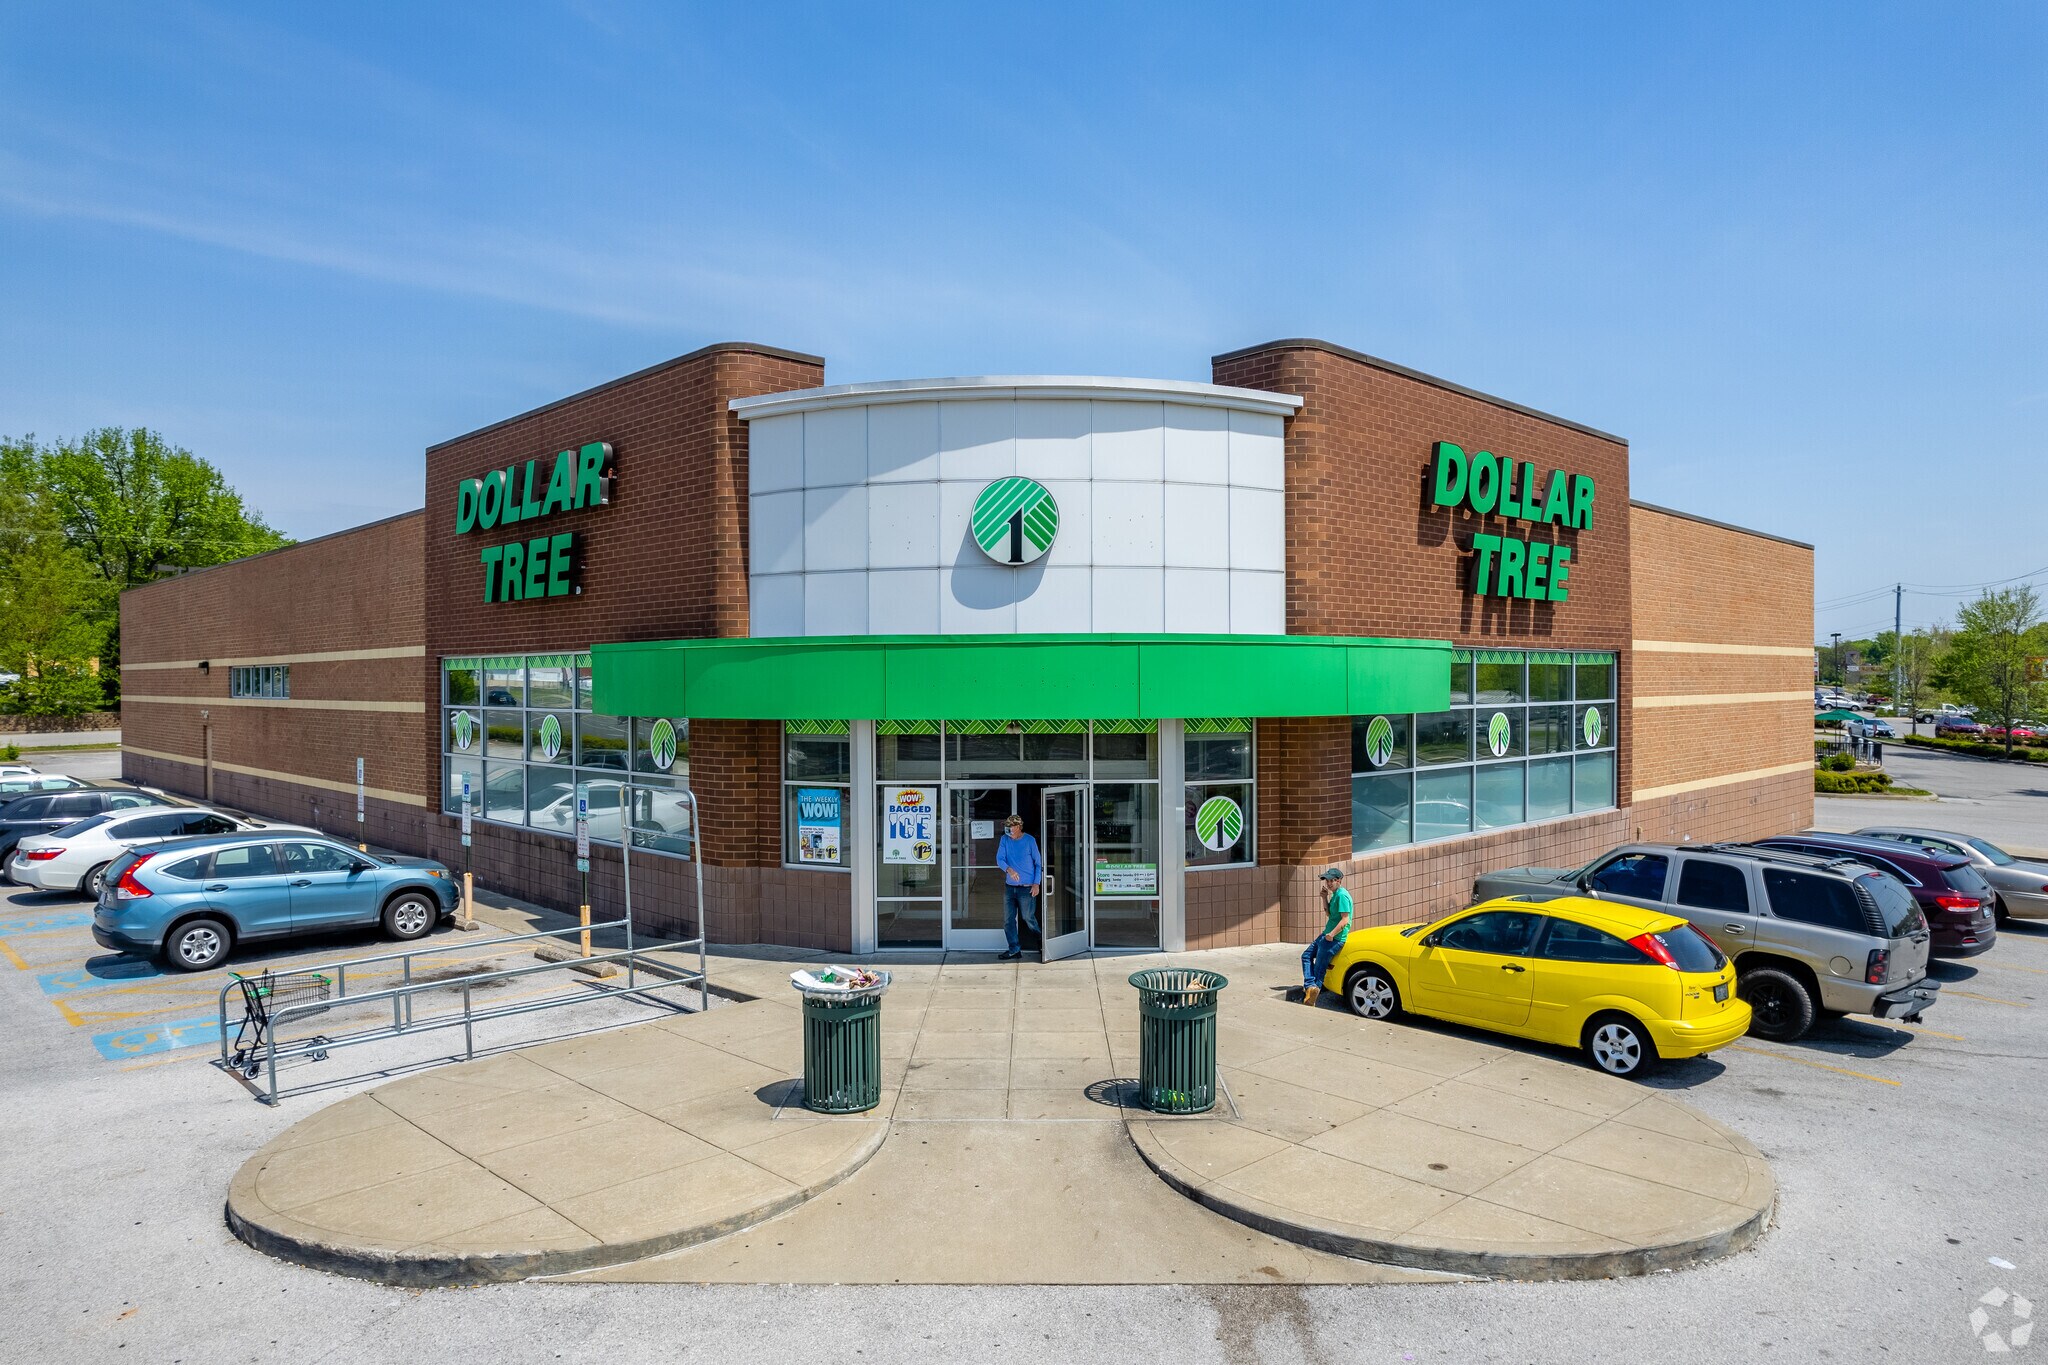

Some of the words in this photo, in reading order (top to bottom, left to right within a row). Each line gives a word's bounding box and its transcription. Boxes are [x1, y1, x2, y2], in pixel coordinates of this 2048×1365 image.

[456, 442, 607, 535] DOLLAR
[1434, 441, 1596, 531] DOLLAR
[1007, 507, 1025, 563] 1
[481, 533, 573, 603] TREE
[1472, 533, 1572, 602] TREE
[801, 795, 812, 803] THE
[801, 803, 839, 818] WOW!
[889, 805, 931, 813] BAGGED
[899, 793, 922, 803] WOW!
[889, 813, 931, 839] ICE
